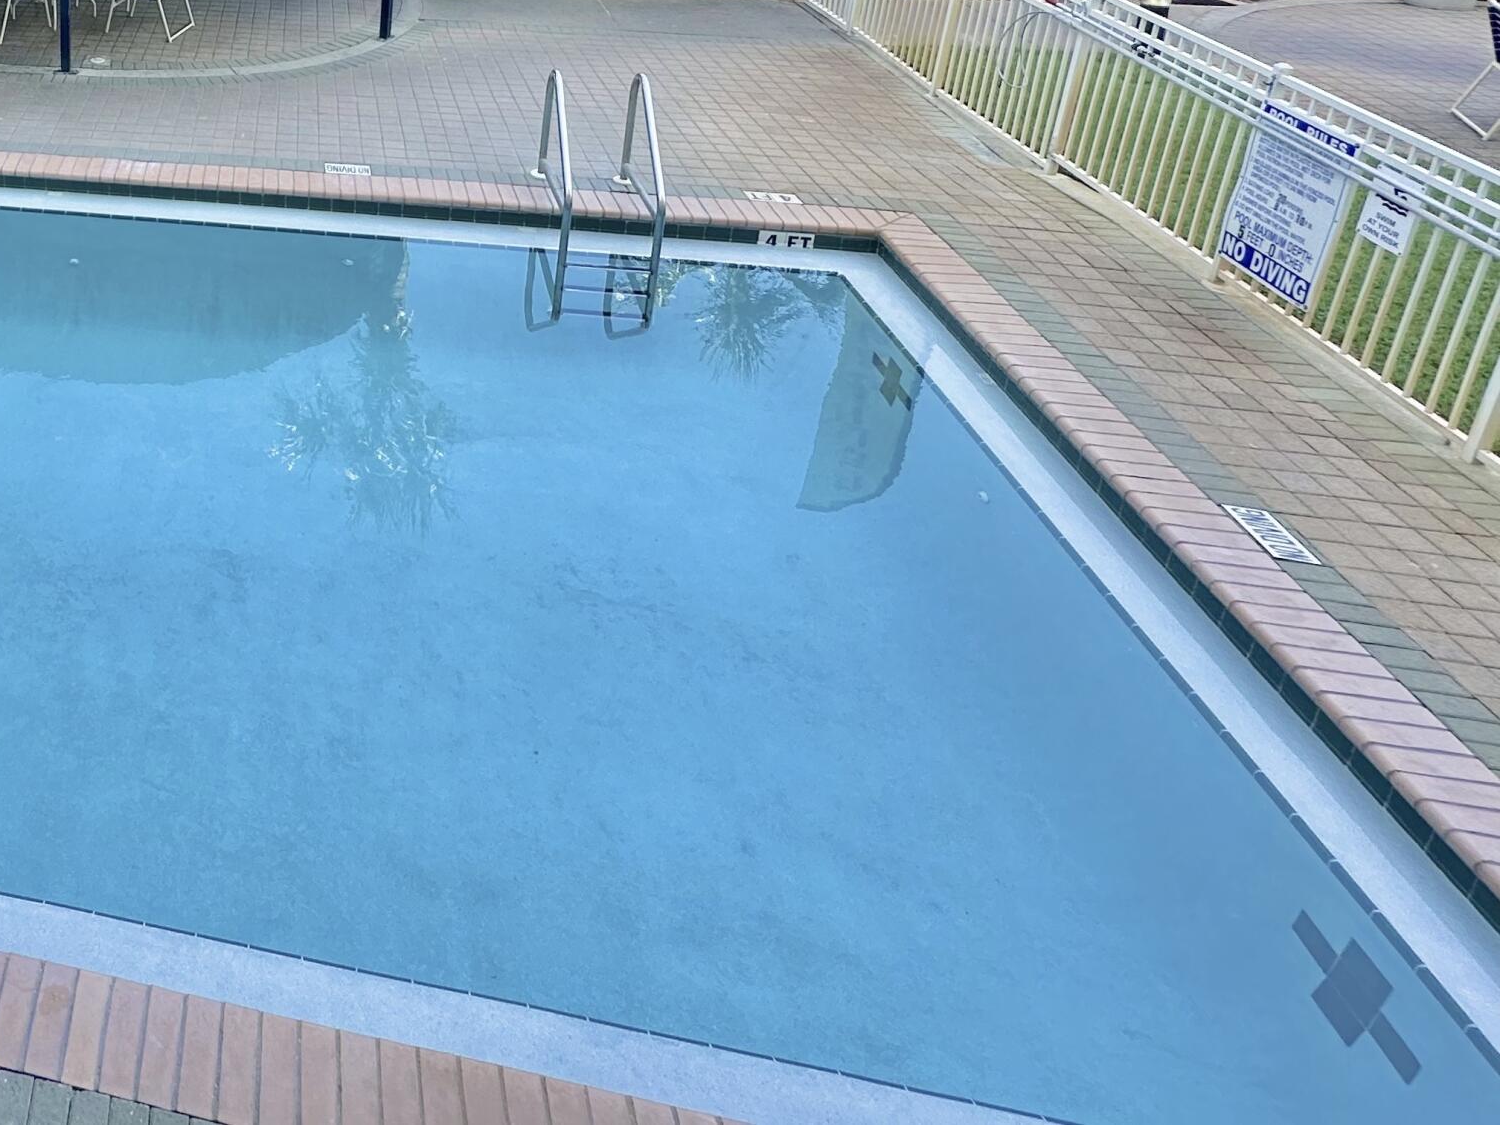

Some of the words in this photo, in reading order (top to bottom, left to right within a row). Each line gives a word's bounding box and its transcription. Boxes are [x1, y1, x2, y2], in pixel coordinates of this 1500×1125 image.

[1238, 225, 1246, 239] 5
[1246, 230, 1264, 248] FEET
[1362, 224, 1380, 238] OWN
[1379, 222, 1400, 239] YOUR
[766, 234, 777, 246] 4
[788, 235, 812, 249] FT
[1222, 232, 1247, 262] NO
[1250, 250, 1307, 305] DIVING
